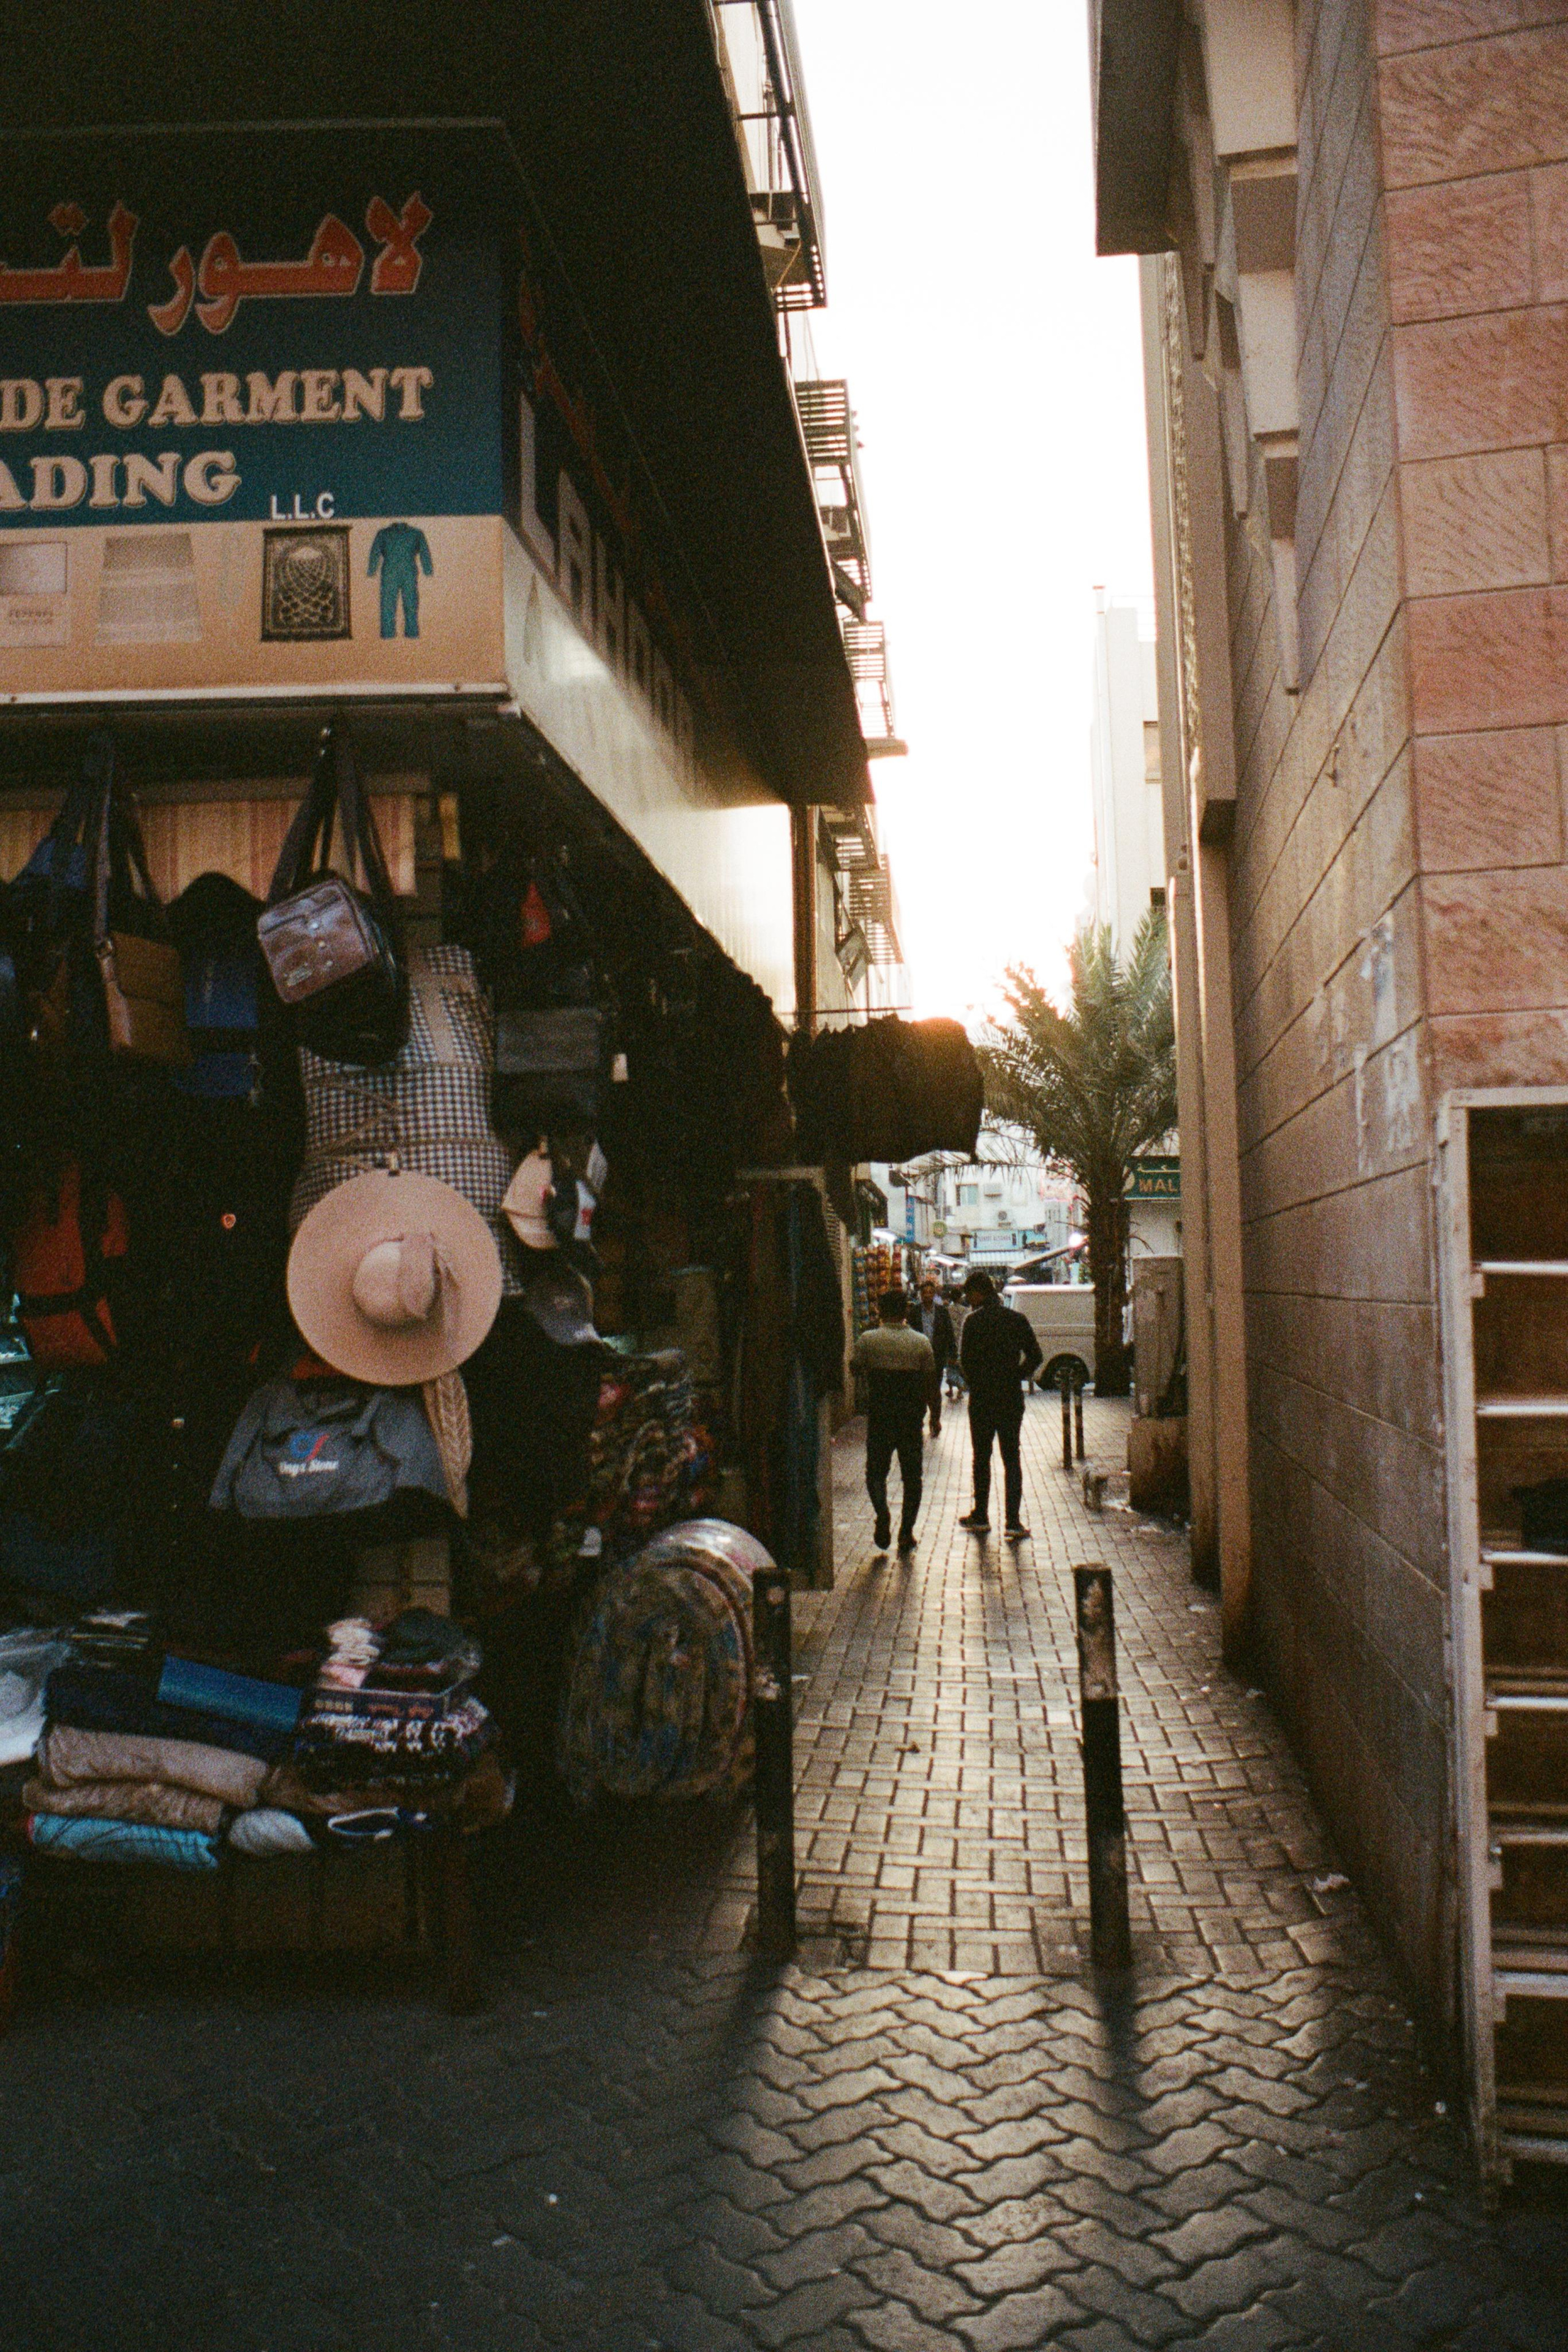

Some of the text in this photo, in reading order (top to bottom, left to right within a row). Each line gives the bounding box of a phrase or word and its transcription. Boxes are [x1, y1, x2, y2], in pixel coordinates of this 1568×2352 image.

[0, 190, 434, 336] لاهور لت
[102, 366, 434, 429] GARMENT
[270, 492, 335, 520] L.L.C
